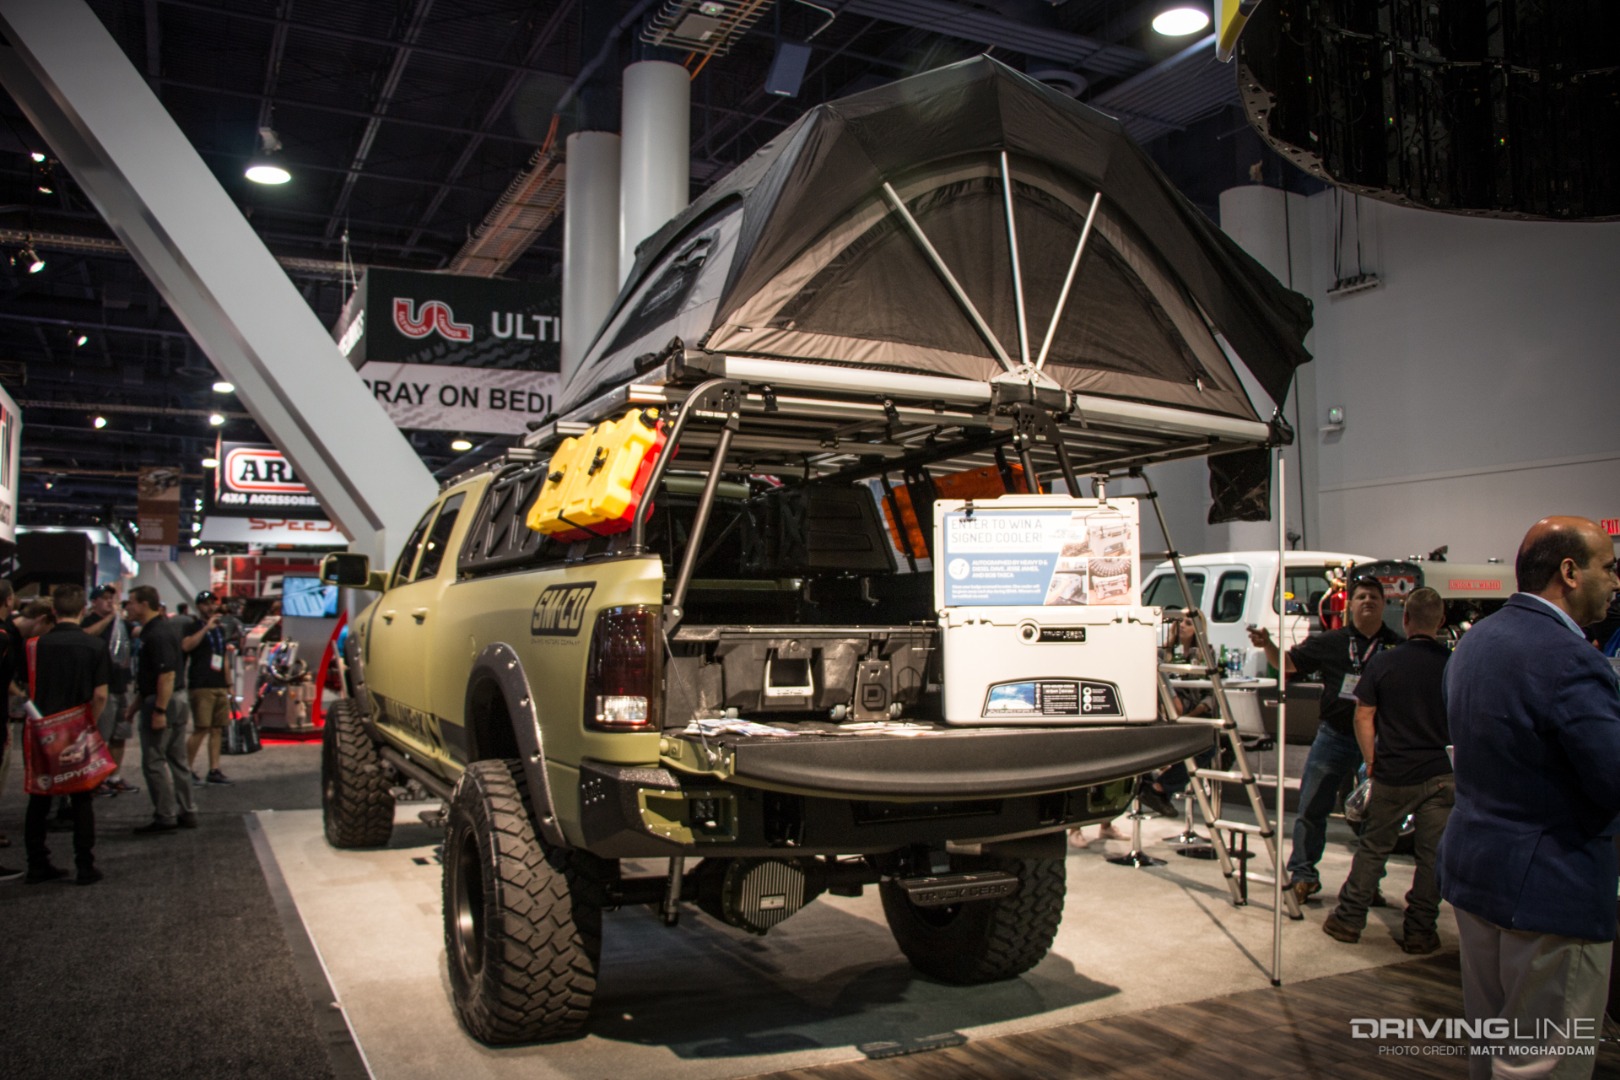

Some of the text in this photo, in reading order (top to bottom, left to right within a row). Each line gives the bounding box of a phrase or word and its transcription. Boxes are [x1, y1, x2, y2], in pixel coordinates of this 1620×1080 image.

[362, 380, 430, 405] RAY
[439, 385, 479, 408] ON
[239, 460, 301, 482] AR
[221, 493, 320, 506] 4X4 ACCESSORIE
[992, 519, 1006, 529] TO
[1008, 518, 1032, 529] WIN
[1034, 518, 1043, 529] A
[1601, 519, 1619, 534] EXIT
[951, 532, 992, 544] SIGNED
[995, 531, 1043, 543] COOLER!
